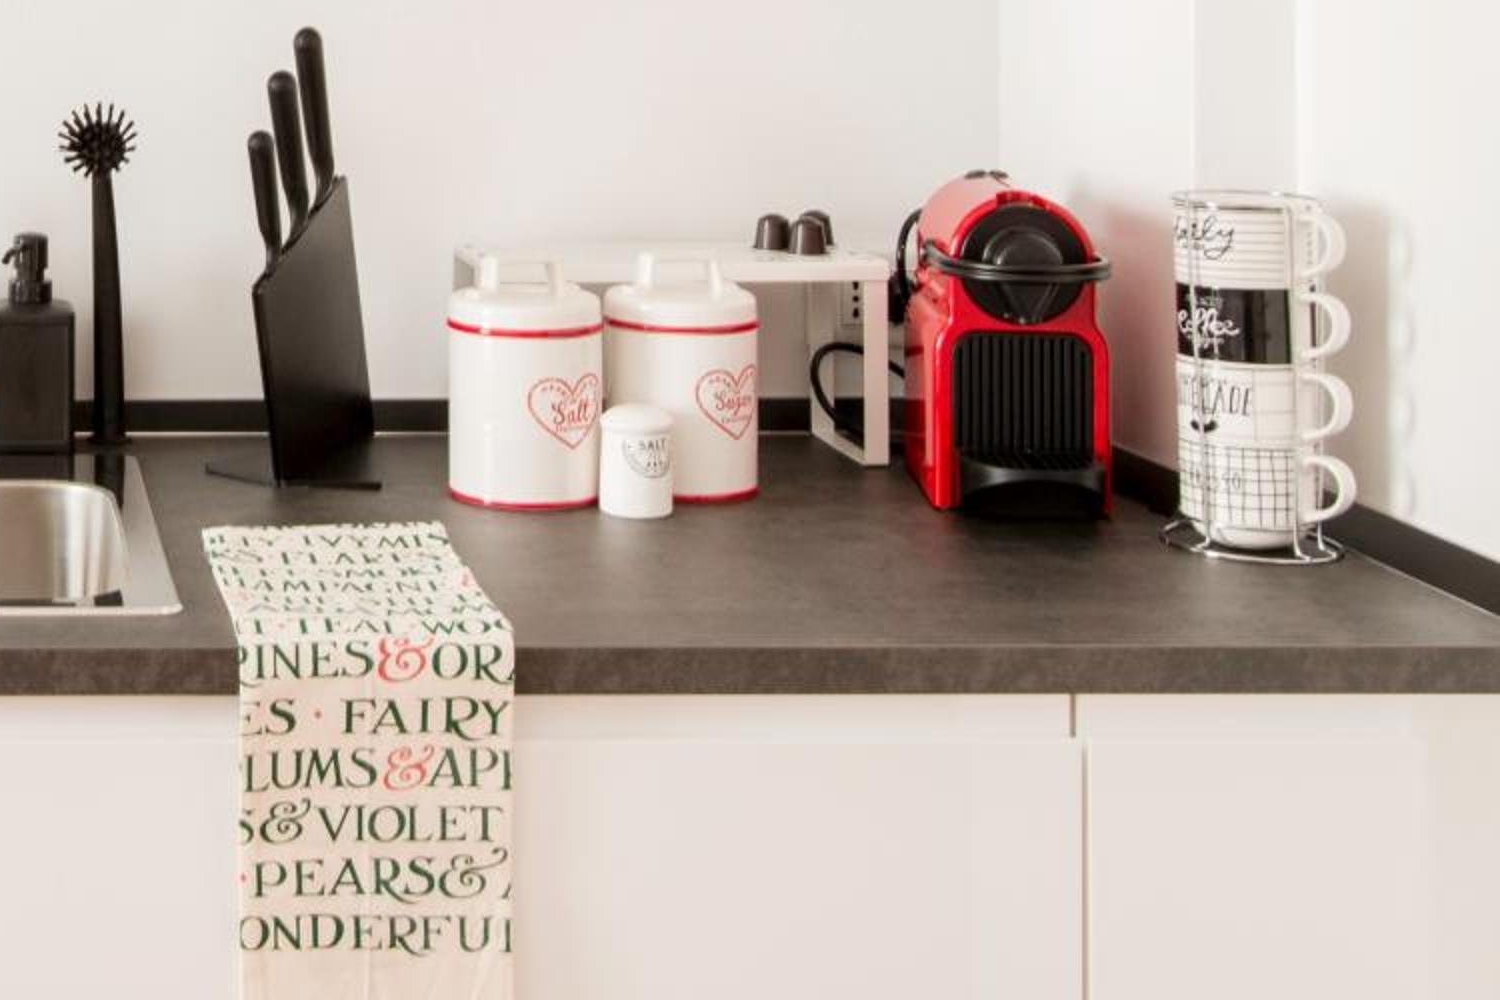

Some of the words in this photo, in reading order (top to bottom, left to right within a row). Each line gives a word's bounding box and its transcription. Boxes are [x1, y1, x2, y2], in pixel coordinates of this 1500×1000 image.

[430, 642, 514, 686] OR
[341, 696, 511, 742] FAIRY
[240, 747, 379, 793] LUMS
[316, 804, 504, 843] VIOLET
